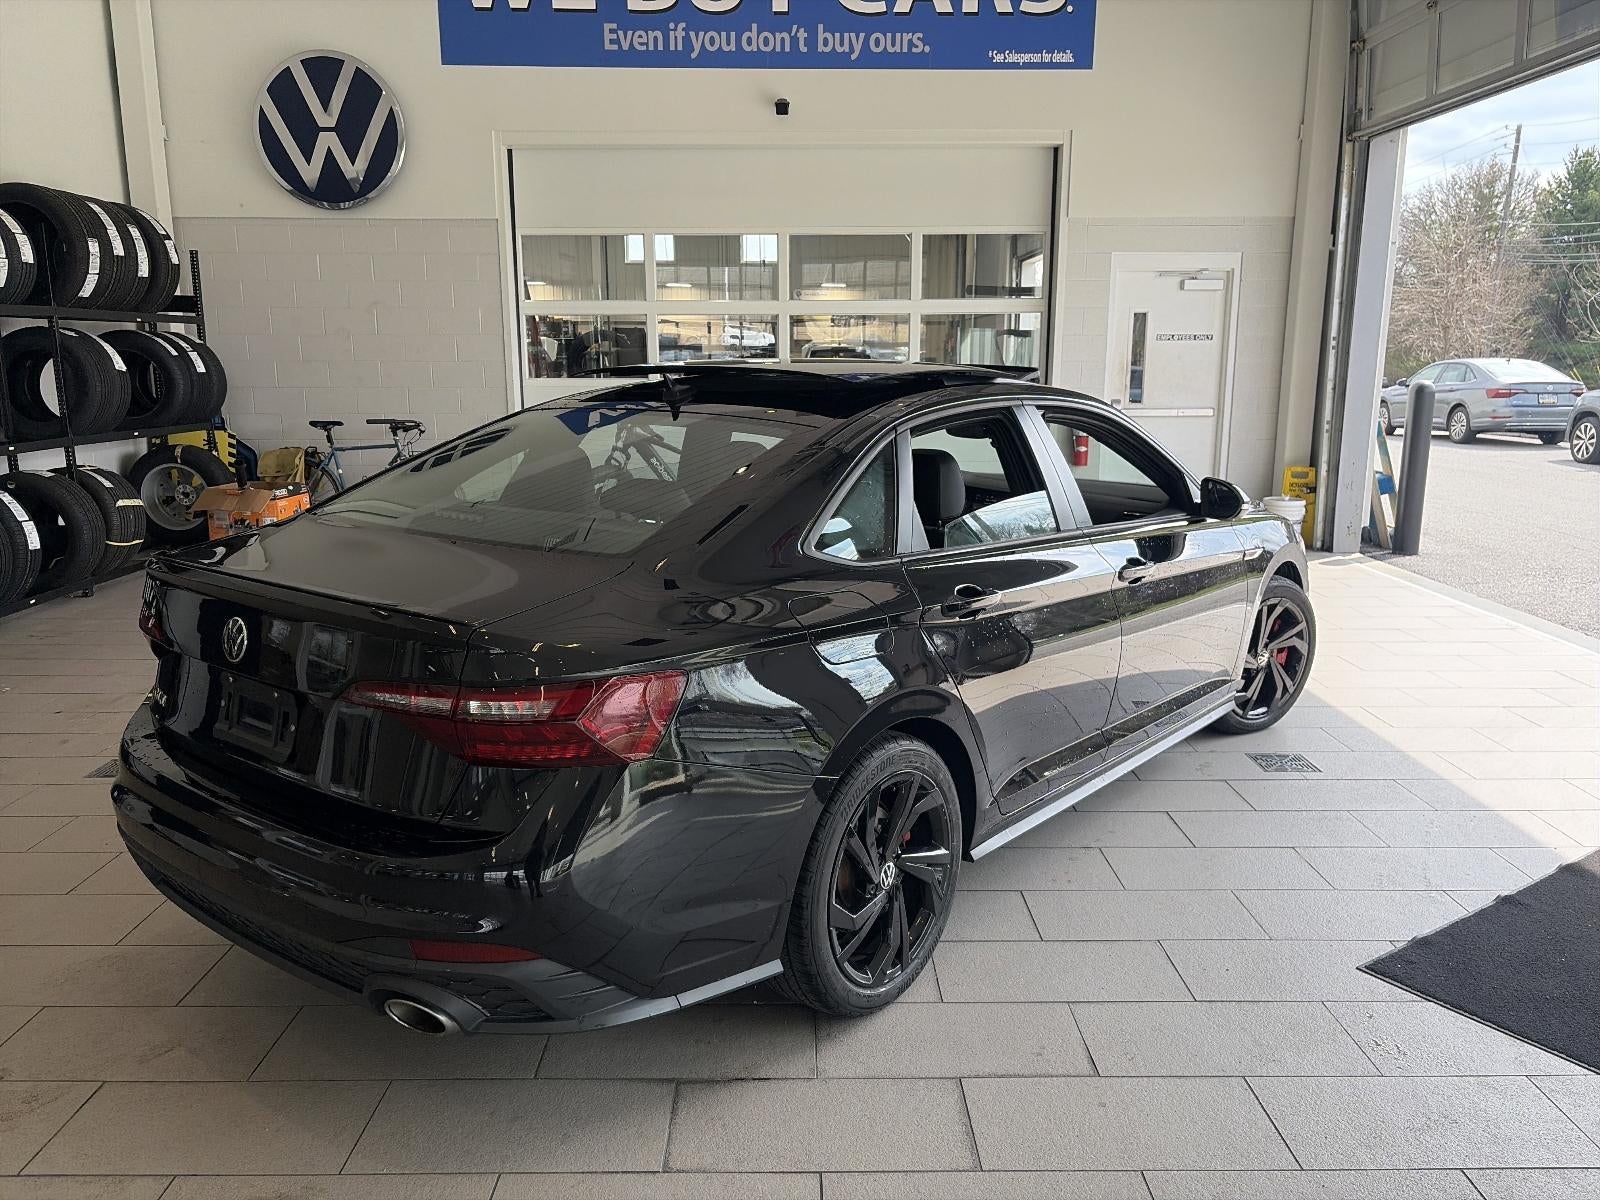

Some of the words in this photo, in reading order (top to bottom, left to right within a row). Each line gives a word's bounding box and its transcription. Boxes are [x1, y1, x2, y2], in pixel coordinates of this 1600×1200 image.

[603, 22, 664, 51] Even
[669, 22, 687, 51] if
[689, 30, 735, 59] you
[741, 23, 808, 53] don't
[817, 24, 865, 60] buy
[869, 31, 931, 53] ours.
[1004, 50, 1041, 66] Salesperson
[1042, 49, 1052, 63] for
[1052, 49, 1075, 63] details.
[256, 54, 402, 200] VW
[1156, 333, 1192, 341] EMPLOYEES
[1193, 333, 1214, 341] ONLY
